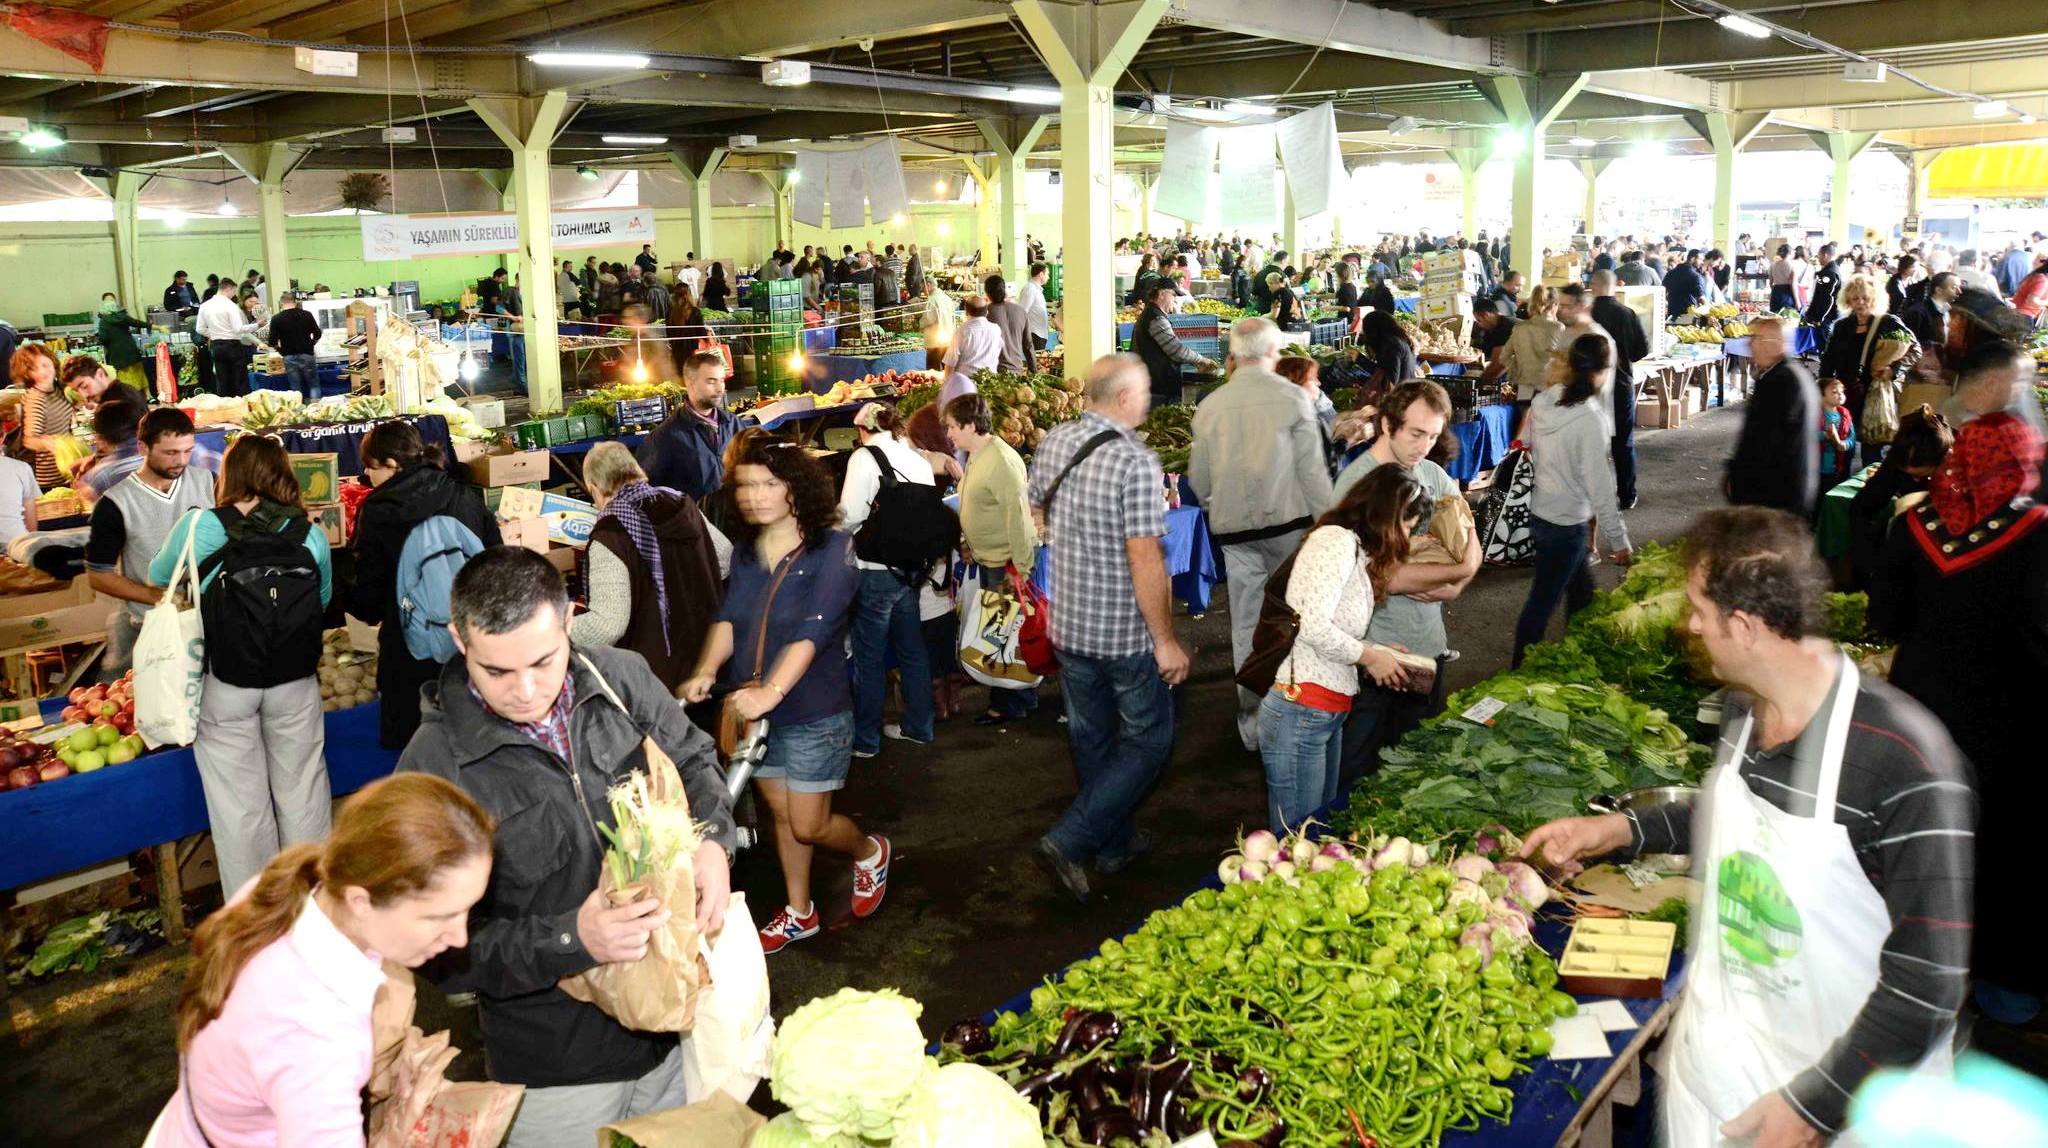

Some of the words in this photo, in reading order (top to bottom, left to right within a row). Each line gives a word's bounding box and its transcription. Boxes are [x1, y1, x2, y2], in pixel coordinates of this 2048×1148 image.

[410, 228, 461, 247] YAŞAMIN
[465, 223, 519, 242] SÜREKLİLİ
[556, 221, 612, 237] TOHUMLAR
